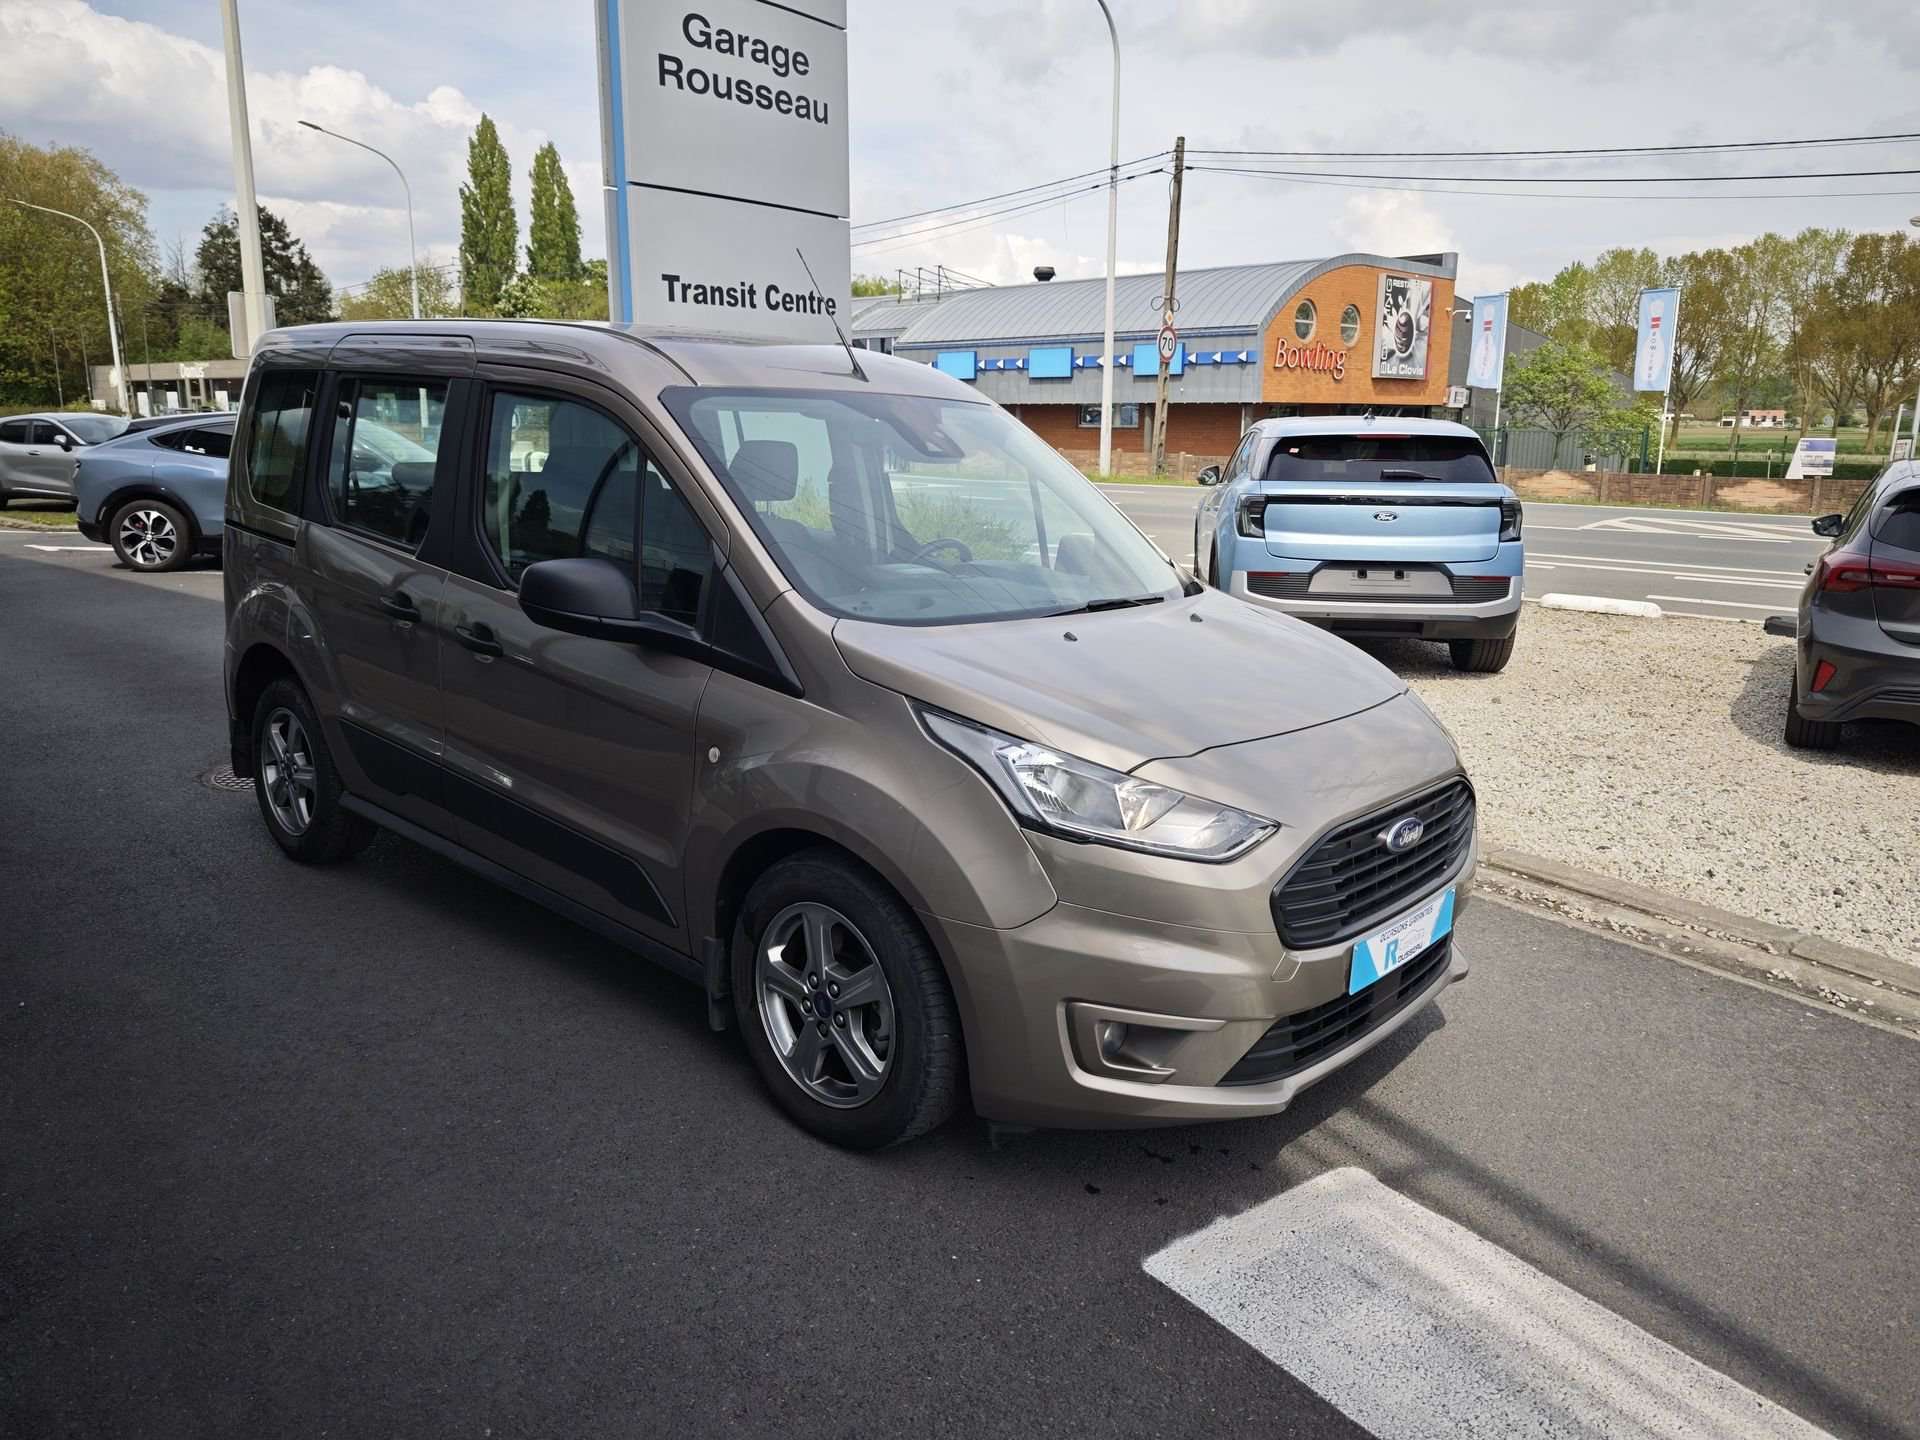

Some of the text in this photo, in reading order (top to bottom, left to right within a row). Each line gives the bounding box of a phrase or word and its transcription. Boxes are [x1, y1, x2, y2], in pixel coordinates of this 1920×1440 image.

[682, 13, 809, 77] Garage
[658, 53, 829, 125] Rousseau
[661, 273, 837, 316] Transit Centre
[1162, 337, 1173, 352] 70
[1274, 337, 1346, 380] Bowling
[1399, 823, 1419, 847] Ford
